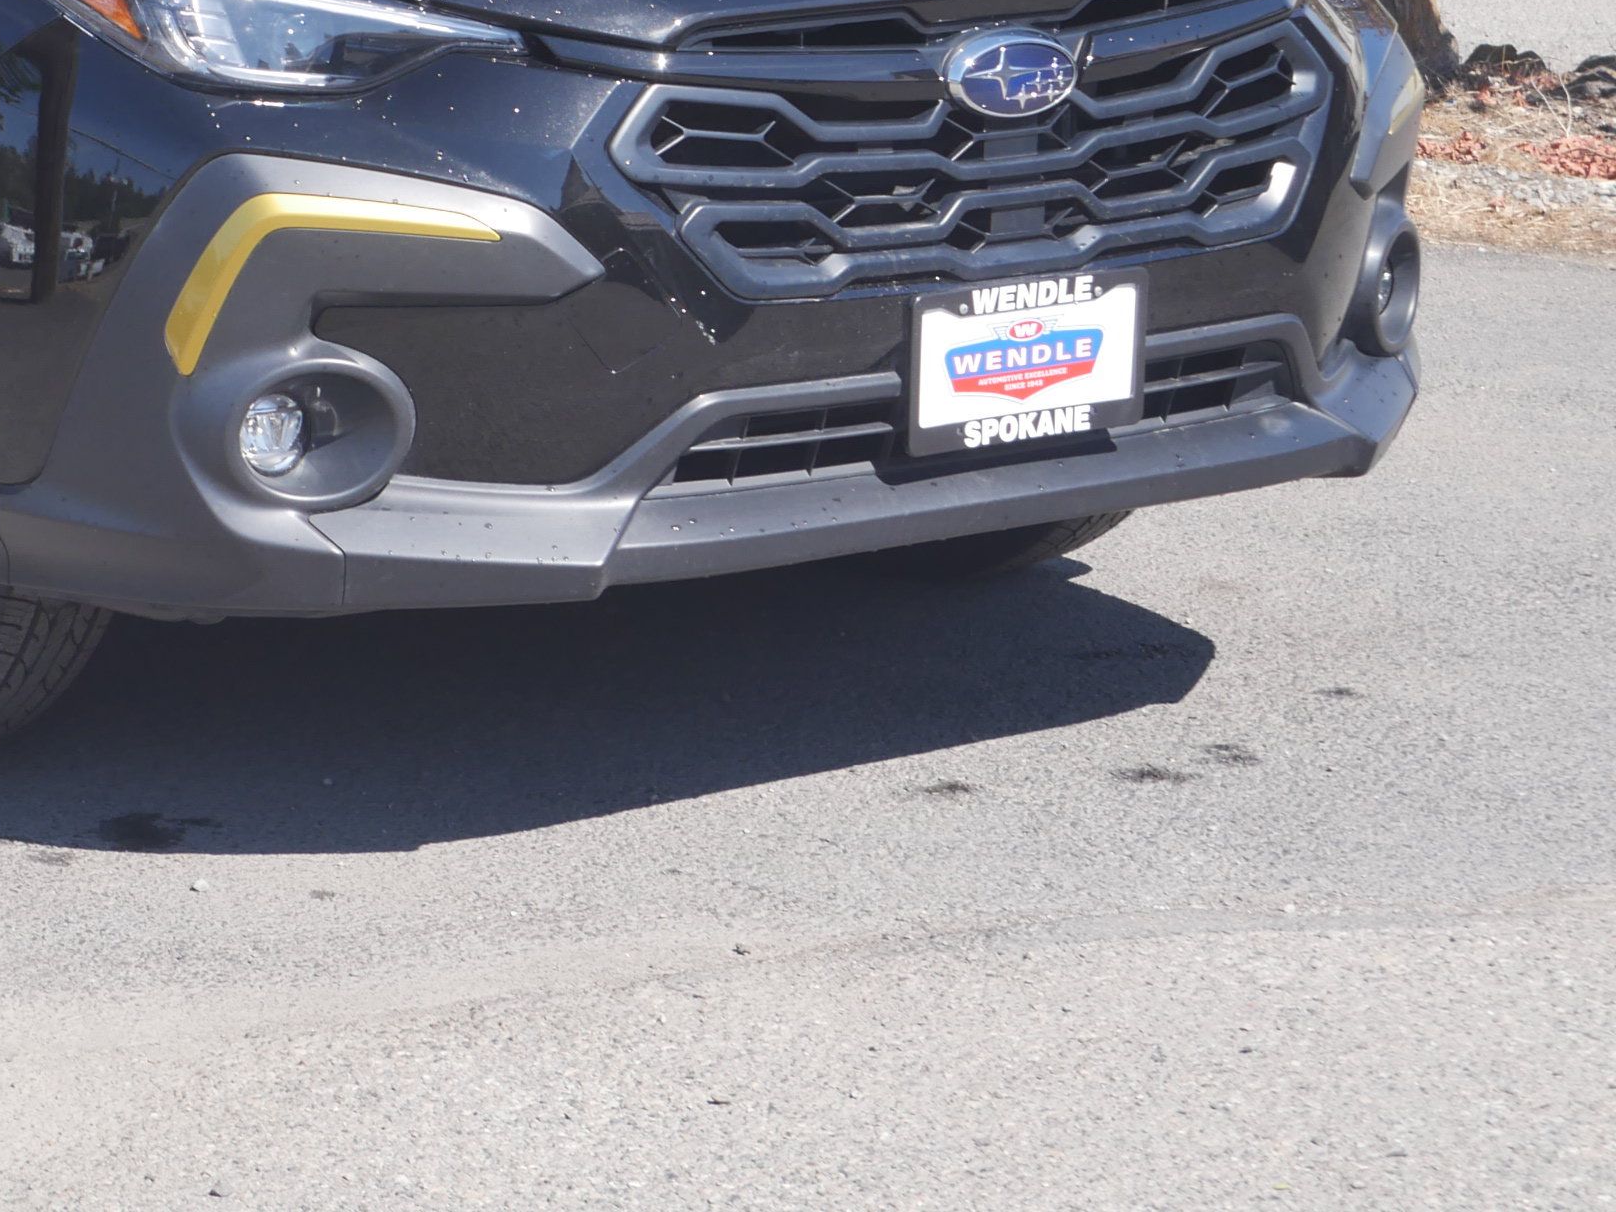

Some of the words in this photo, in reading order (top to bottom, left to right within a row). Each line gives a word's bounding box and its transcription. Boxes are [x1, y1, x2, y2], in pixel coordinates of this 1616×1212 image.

[972, 275, 1094, 314] WENDLE
[953, 338, 1092, 375] WENDLE
[978, 373, 1023, 386] AUTOMOTIVE
[1024, 367, 1068, 380] EXCELLENCE
[1004, 381, 1026, 391] SINCE
[963, 404, 1091, 448] SPOKANE
